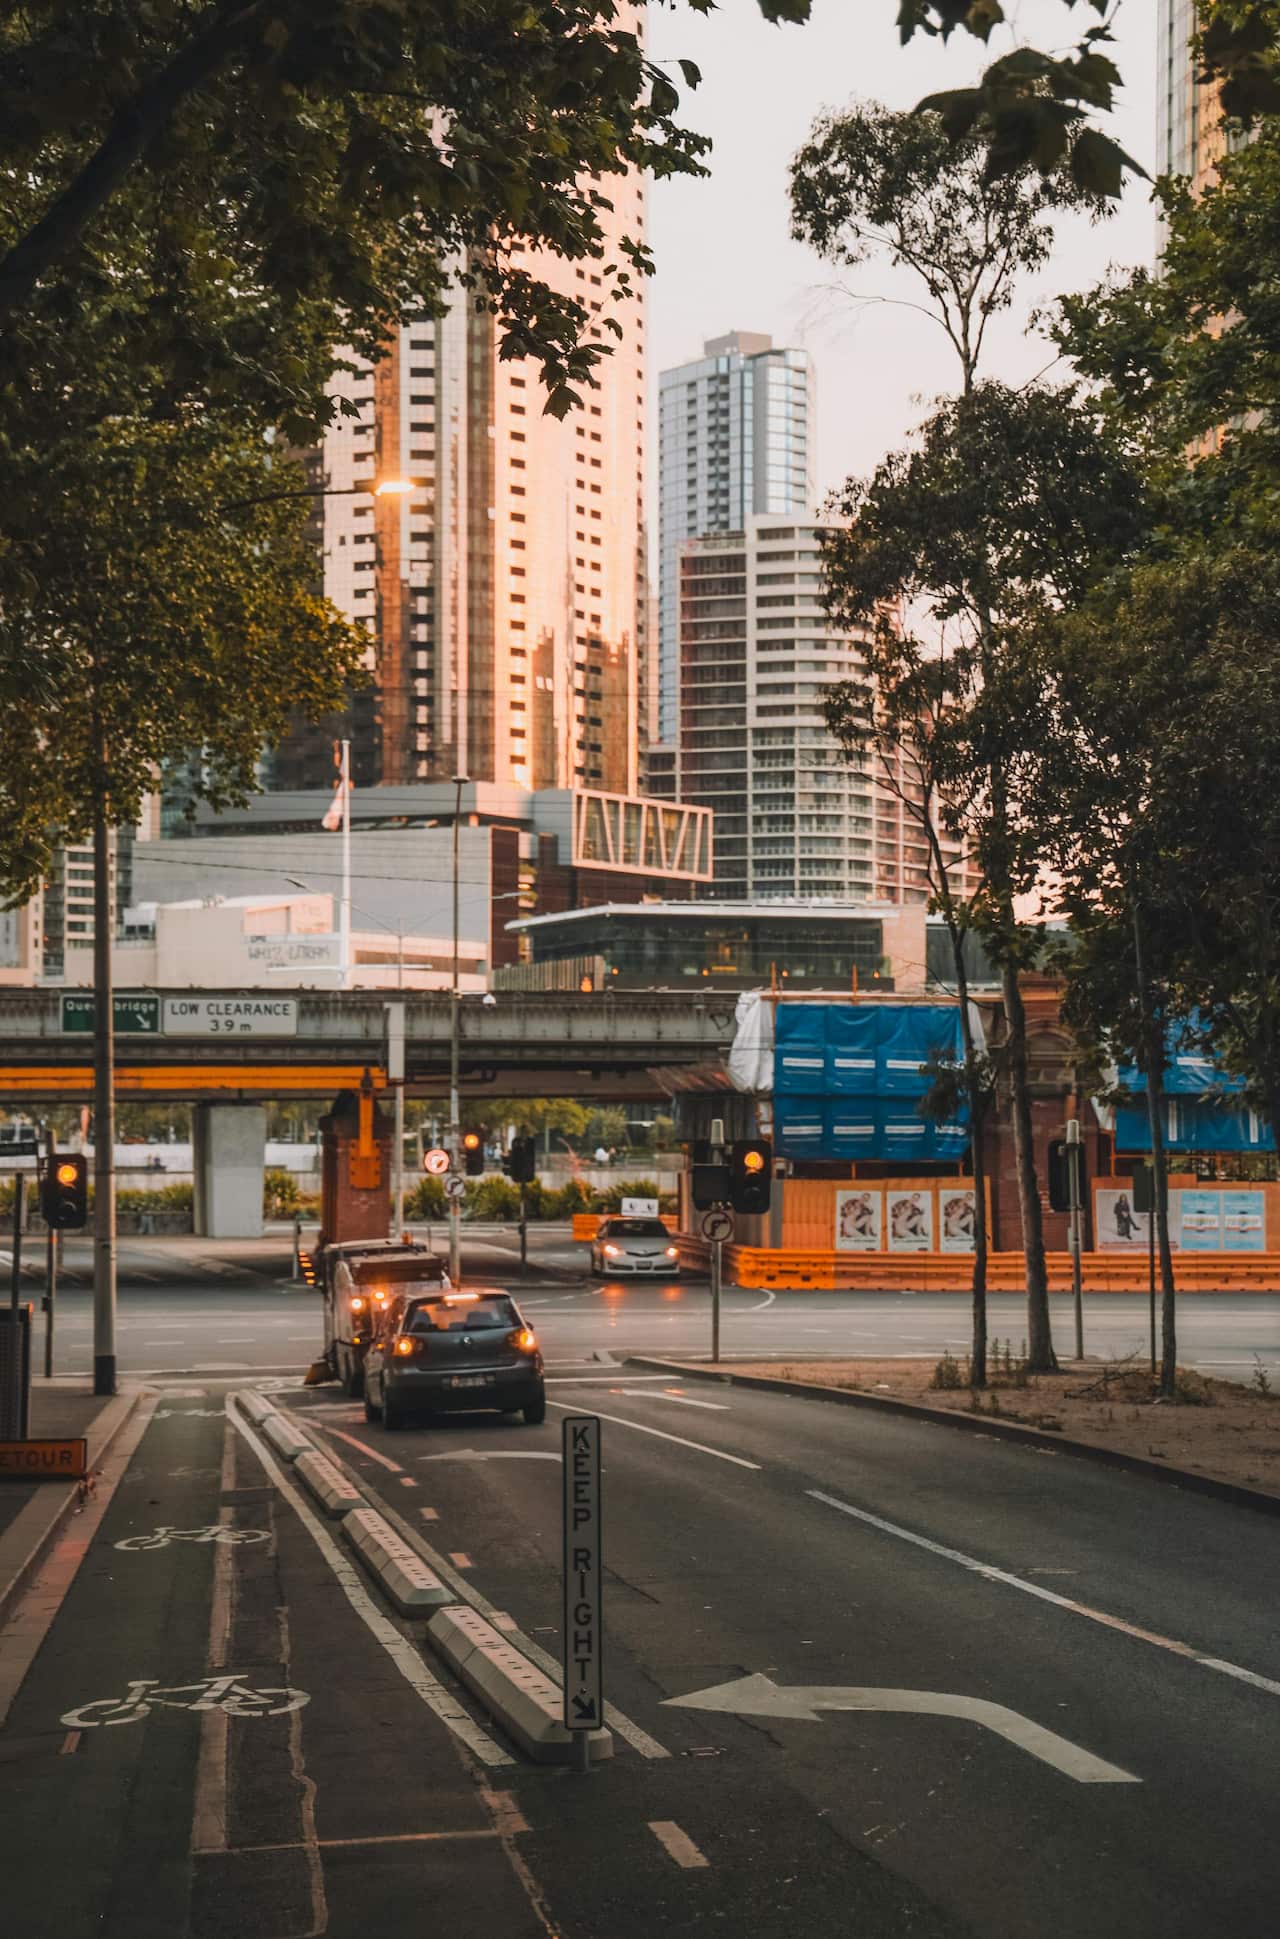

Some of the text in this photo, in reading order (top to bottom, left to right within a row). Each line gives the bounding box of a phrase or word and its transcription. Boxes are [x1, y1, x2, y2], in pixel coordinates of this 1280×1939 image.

[66, 1000, 156, 1014] Quebridge
[170, 1002, 290, 1016] LOW CLEARANCE
[210, 1019, 252, 1032] 3.9 m
[0, 1450, 72, 1466] ETOUR
[572, 1426, 592, 1681] KEEP RIGHT
